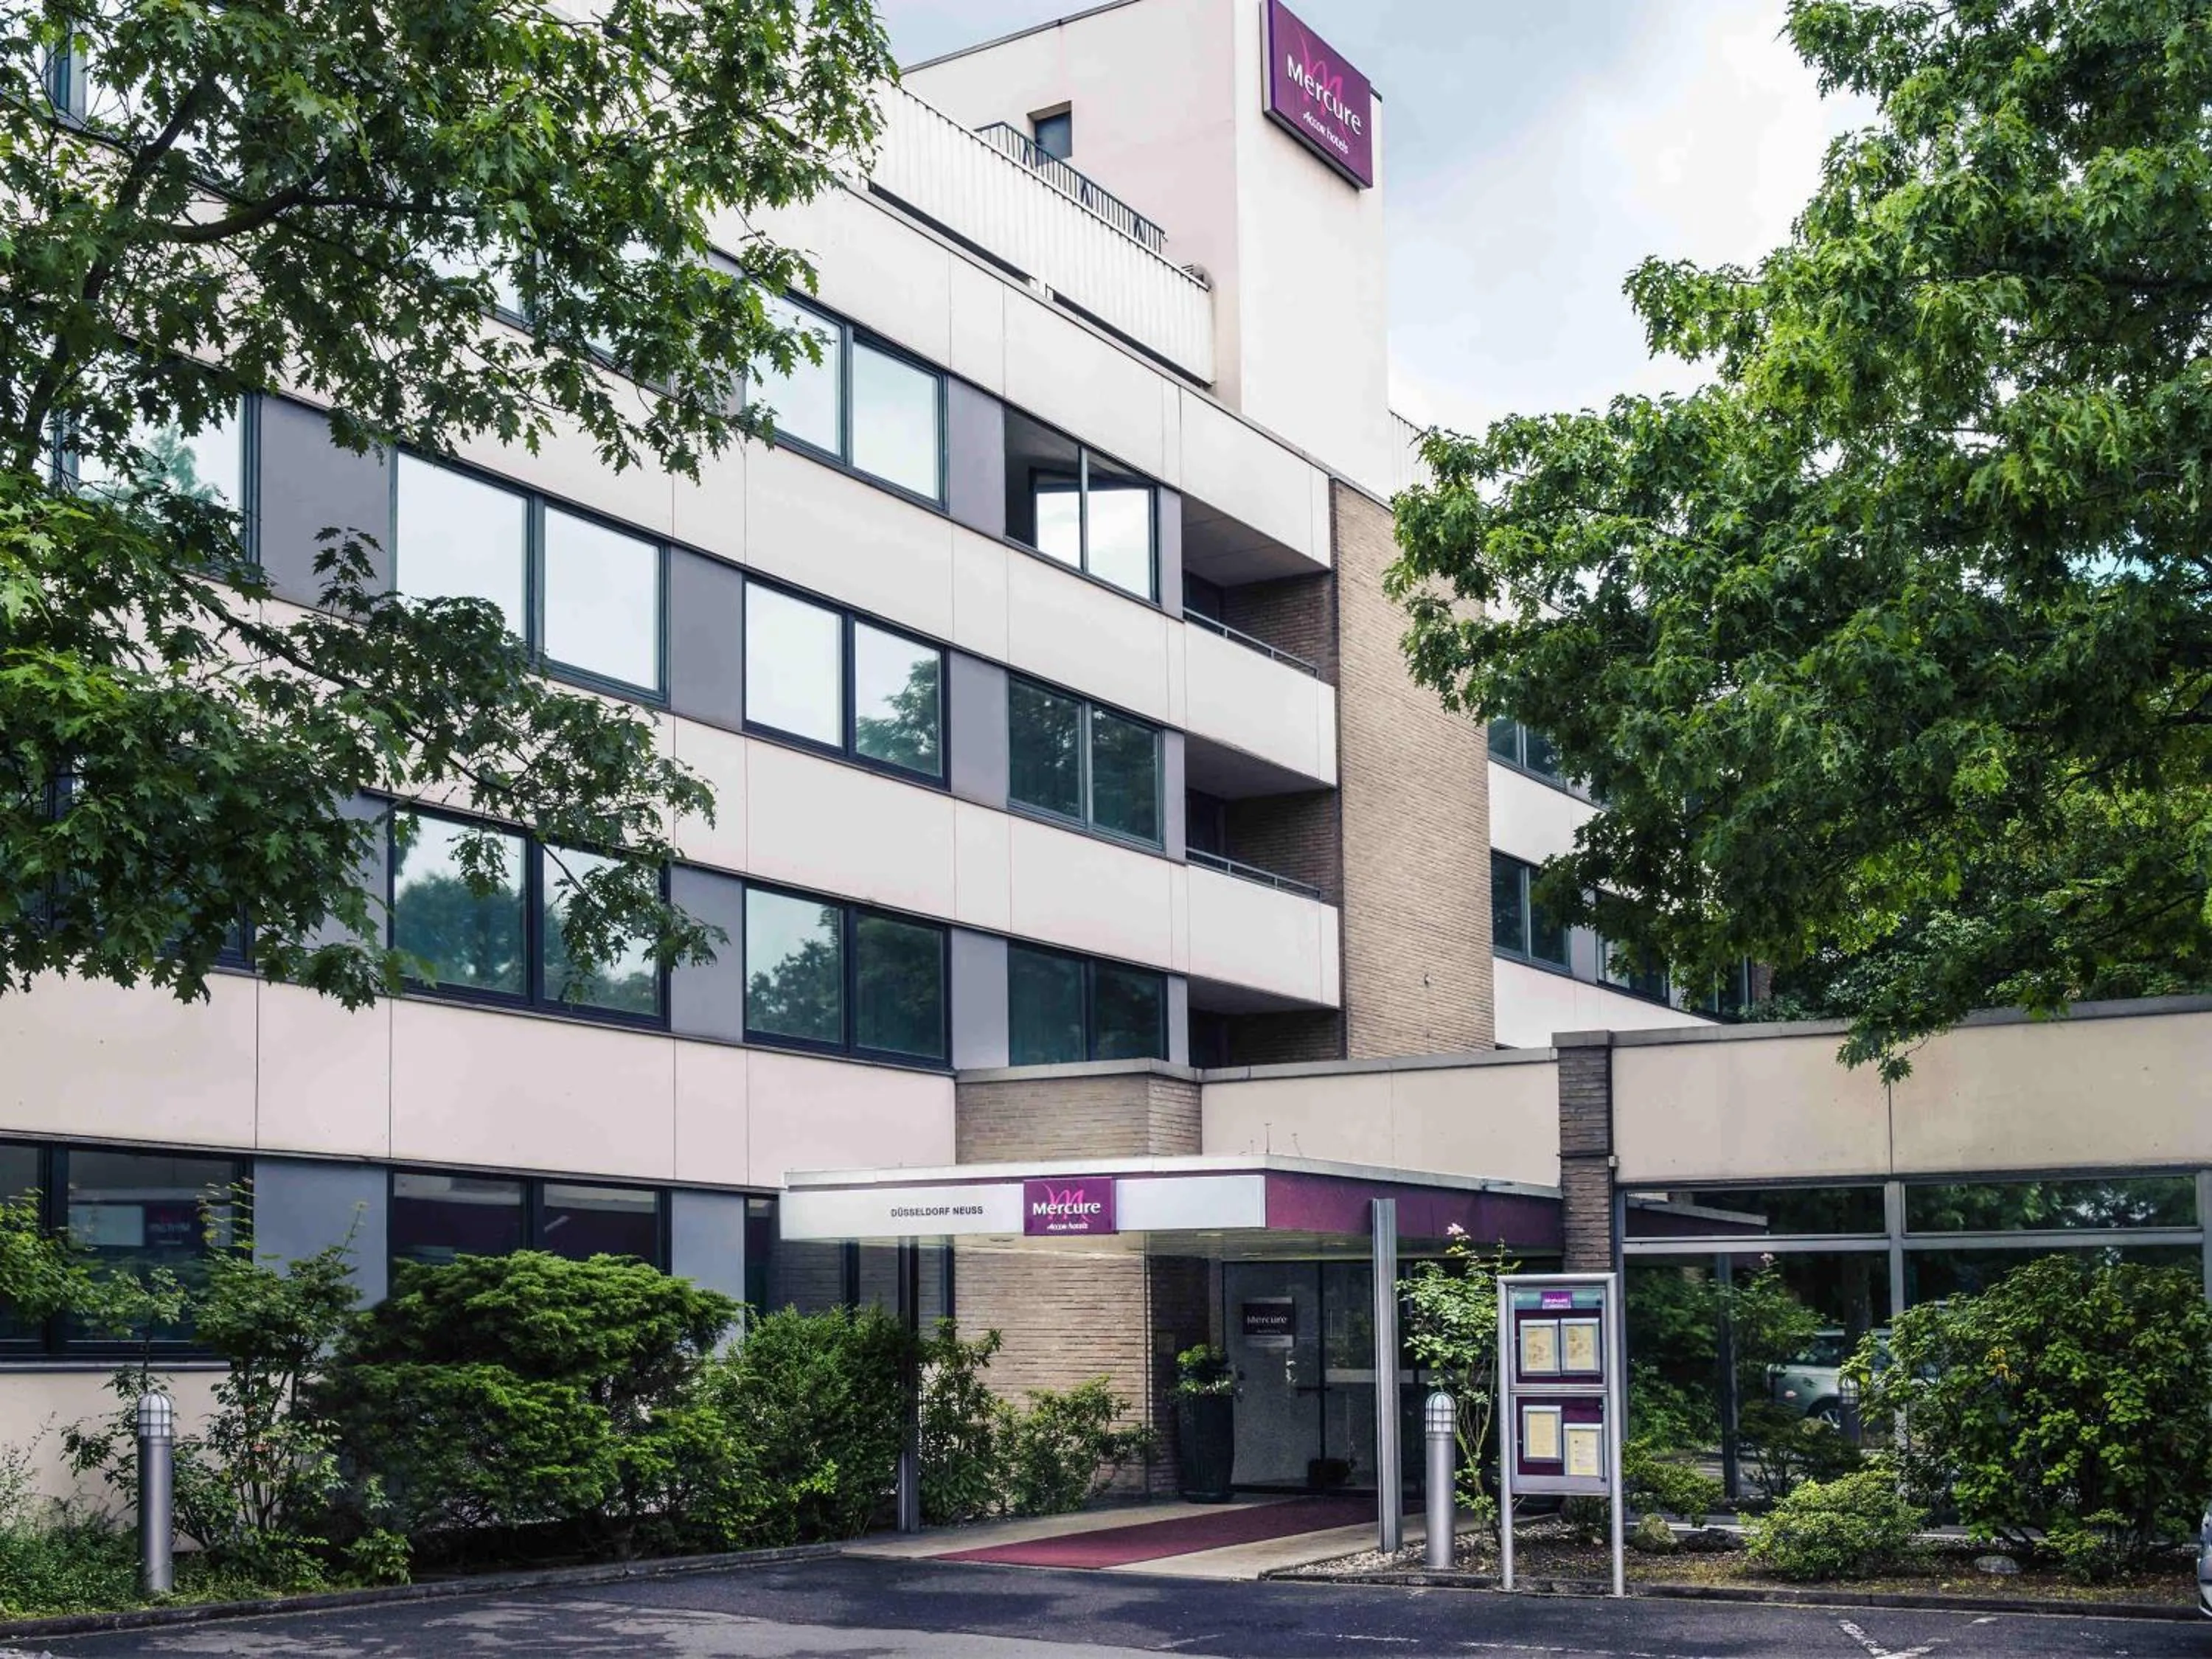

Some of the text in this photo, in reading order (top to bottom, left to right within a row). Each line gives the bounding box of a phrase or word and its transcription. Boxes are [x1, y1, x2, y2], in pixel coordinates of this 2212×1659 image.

[1287, 53, 1362, 135] Mercure
[891, 1206, 984, 1217] DÜSSELDORF NEUSS
[1032, 1201, 1101, 1215] Mercure
